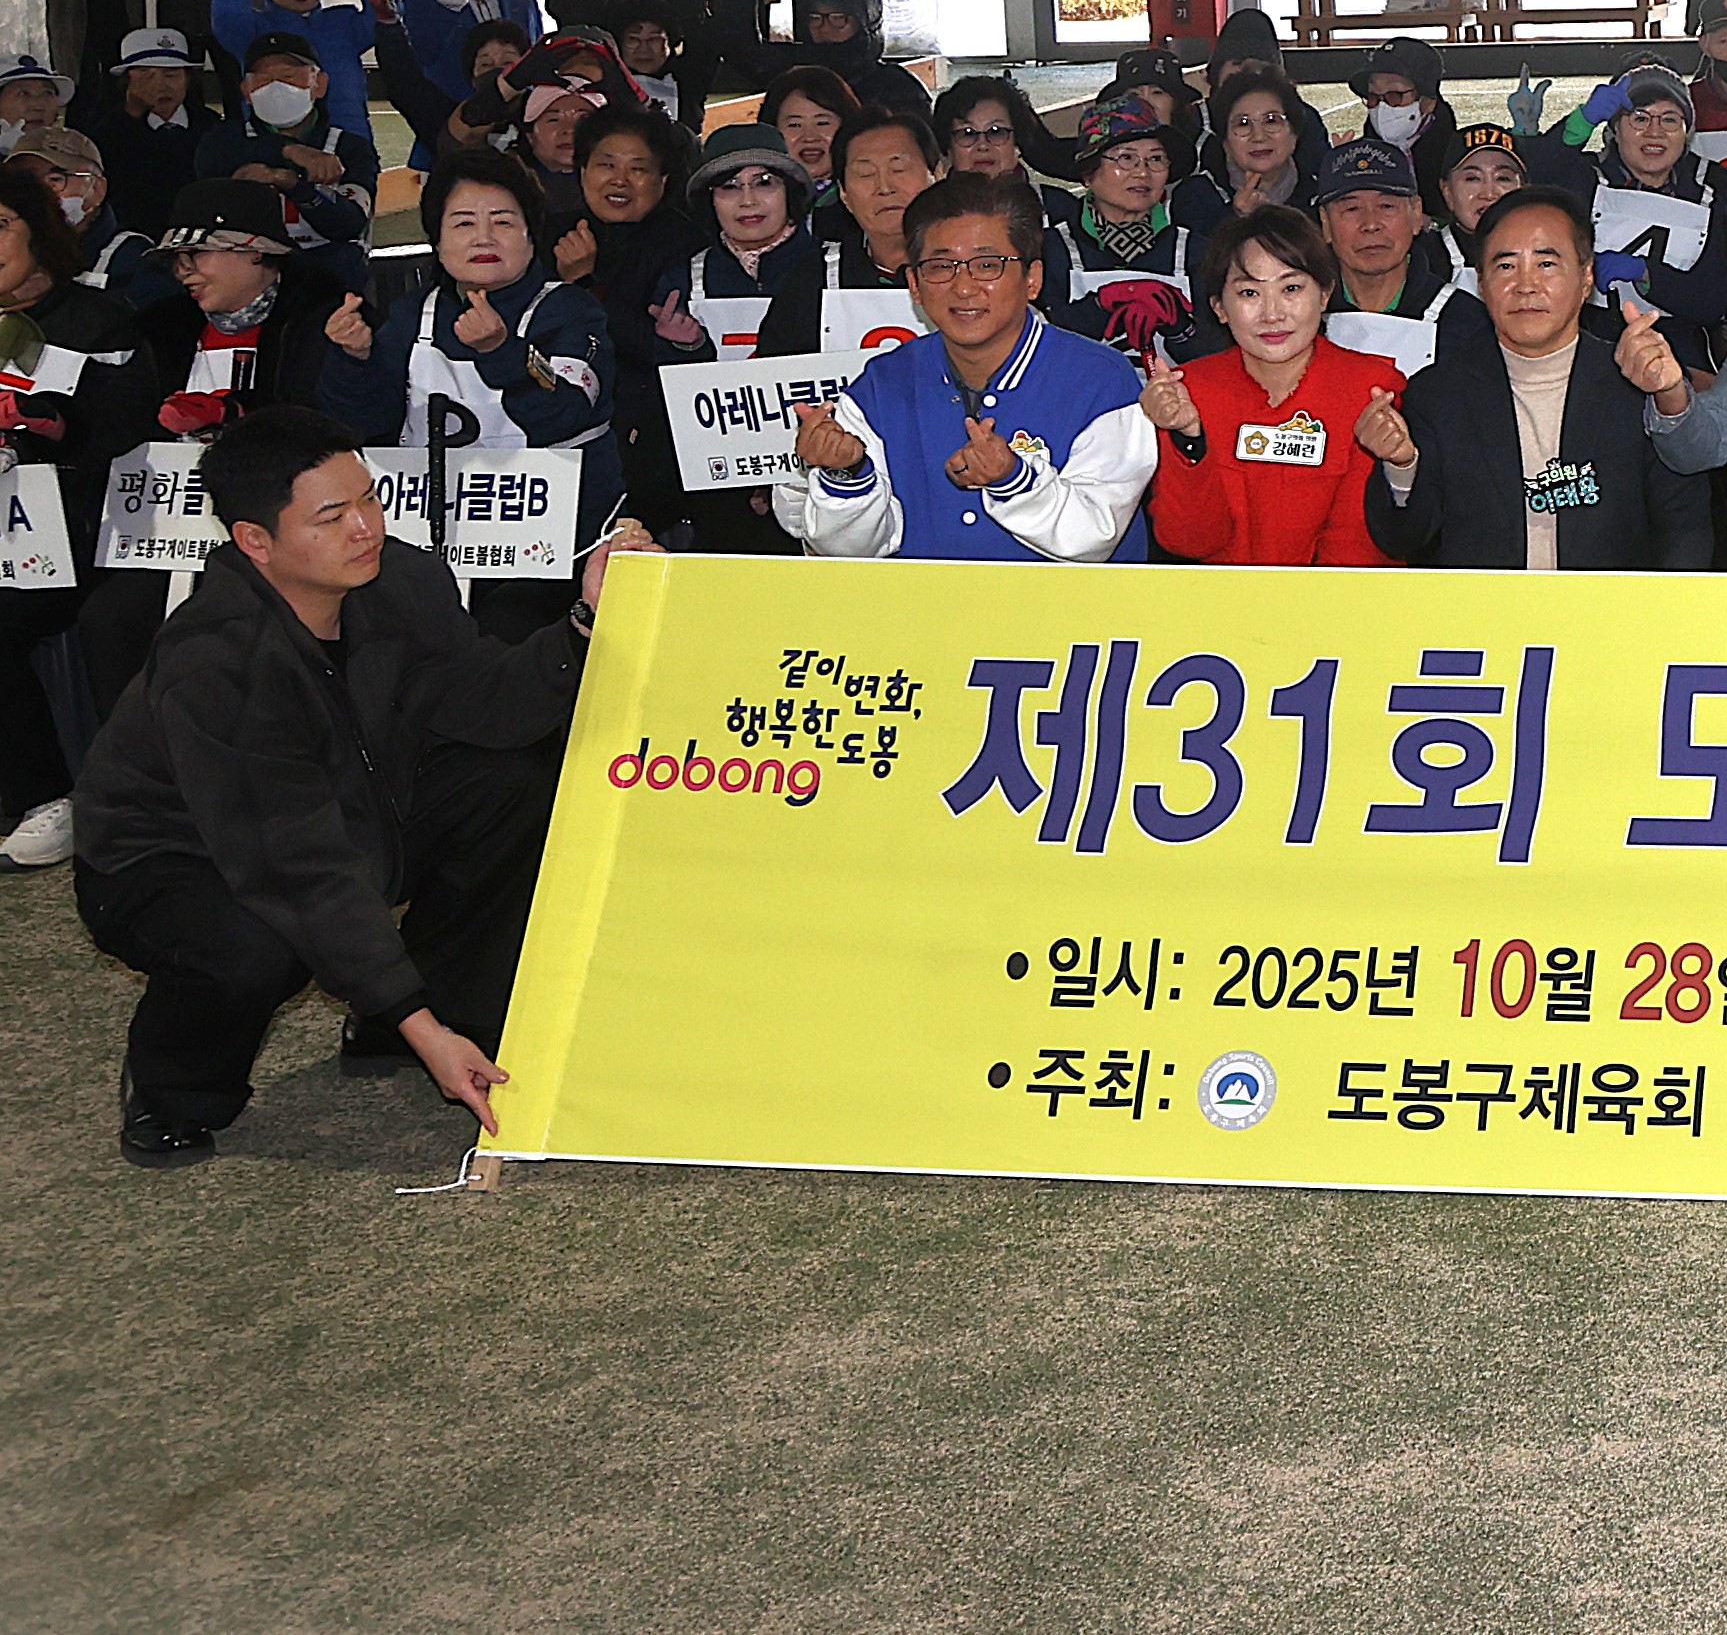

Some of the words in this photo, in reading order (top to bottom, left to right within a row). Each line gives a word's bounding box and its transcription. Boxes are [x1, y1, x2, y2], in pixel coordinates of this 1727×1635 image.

[1272, 442, 1316, 458] 강혜란
[1538, 463, 1578, 487] 구의원
[779, 650, 846, 688] 같이
[843, 669, 923, 720] 변화,
[608, 737, 821, 807] dobong
[726, 697, 840, 749] 행복한
[836, 726, 899, 779] 도봉
[942, 640, 1555, 863] 제31회
[1048, 937, 1184, 1011] 일시:
[1213, 946, 1420, 1017] 2025년
[1453, 939, 1596, 1023] 10월
[1026, 1050, 1175, 1120] 주최:
[1328, 1059, 1706, 1137] 도봉구체육회
